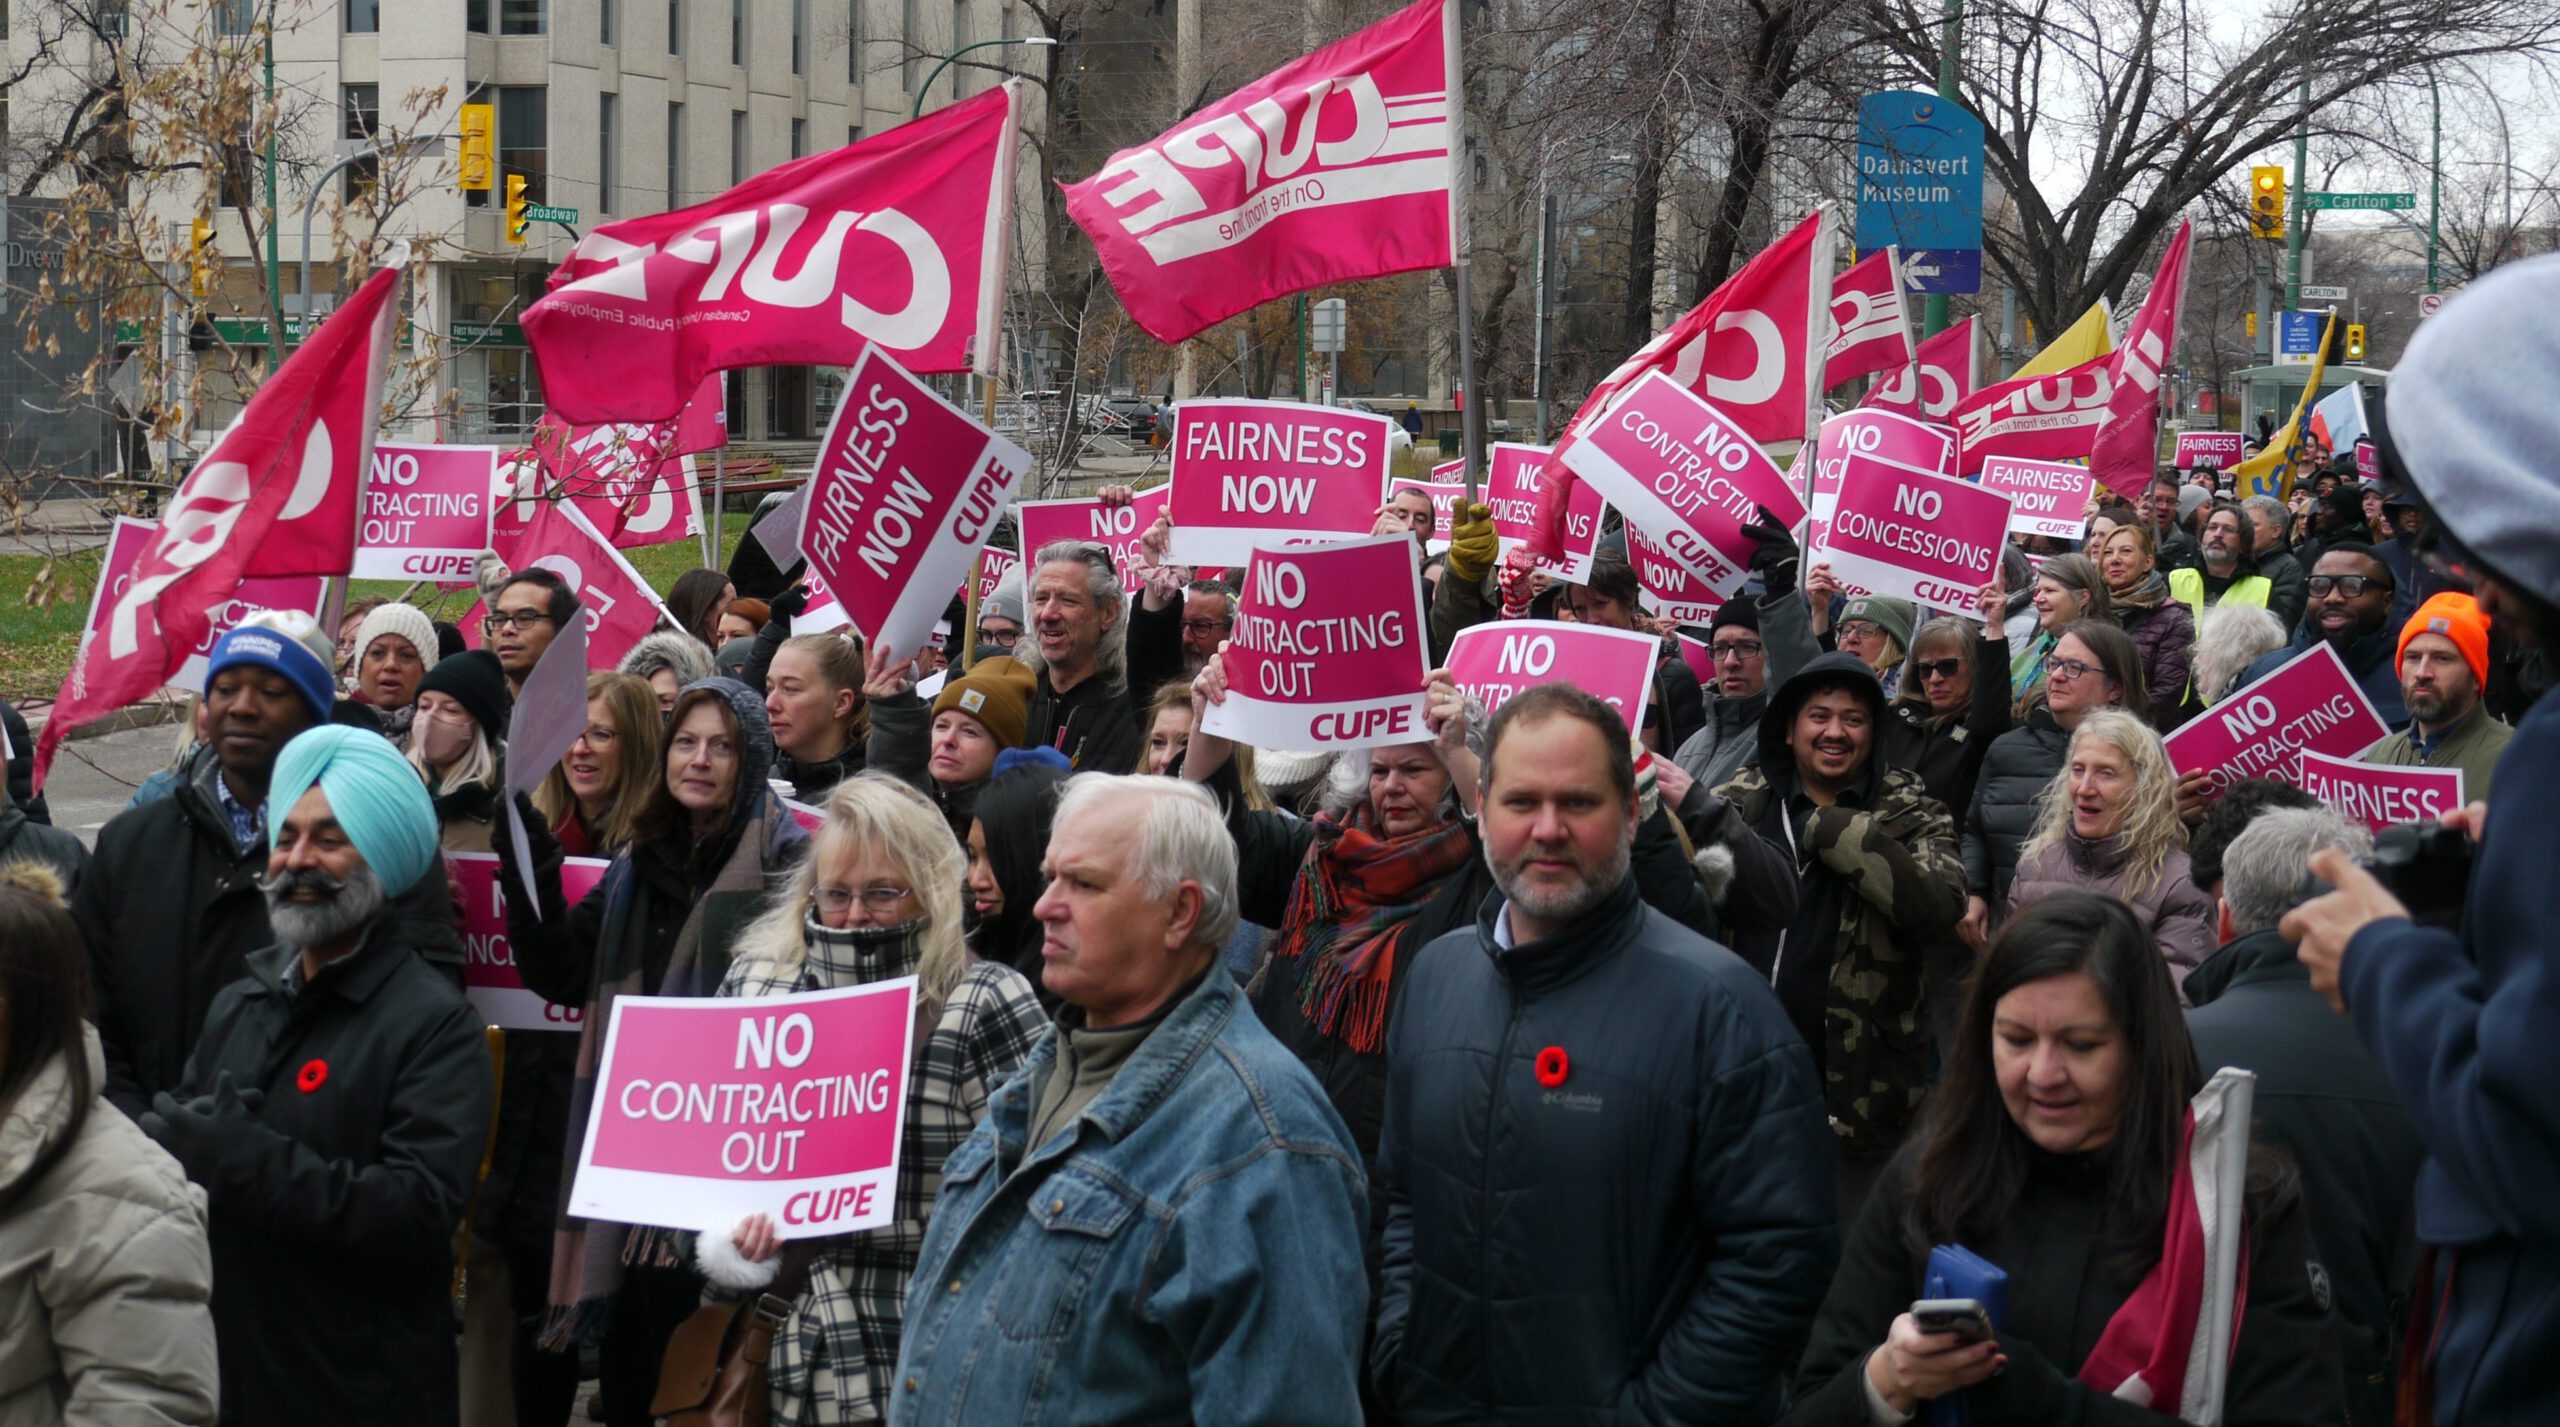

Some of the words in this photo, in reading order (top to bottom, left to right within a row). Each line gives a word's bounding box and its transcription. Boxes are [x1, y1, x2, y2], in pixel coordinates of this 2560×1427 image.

[1863, 184, 1949, 202] Museum
[2332, 196, 2388, 208] Carlton
[2396, 196, 2411, 208] St
[527, 206, 577, 223] Broadway
[2303, 288, 2338, 297] CARLTON
[1186, 421, 1368, 468] FAIRNESS
[1693, 422, 1750, 472] NO
[1838, 424, 1882, 451] NO
[2182, 438, 2236, 452] FAIRNESS
[369, 453, 419, 486] NO
[1991, 465, 2085, 493] FAIRNESS
[2193, 454, 2223, 467] NOW
[814, 383, 909, 577] FAIRNESS
[1222, 475, 1317, 514] NOW
[1655, 471, 1709, 517] OUT
[362, 491, 479, 517] TRACTING
[952, 456, 1013, 545] CUPE
[1893, 483, 1942, 520] NO
[2011, 490, 2058, 513] NOW
[363, 519, 416, 544] OUT
[857, 466, 934, 580] NOW
[1091, 505, 1136, 537] NO
[2036, 521, 2077, 535] CUPE
[1665, 529, 1733, 585] CUPE
[1836, 509, 1993, 572] CONCESSIONS
[403, 555, 475, 576] CUPE
[1257, 559, 1306, 609] NO
[1643, 557, 1687, 593] NOW
[1913, 580, 1978, 610] CUPE
[1497, 635, 1556, 676] NO
[1260, 659, 1316, 698] OUT
[1309, 704, 1412, 742] CUPE
[2221, 694, 2276, 744] NO
[2196, 694, 2356, 796] CONTRACTING
[734, 1013, 814, 1070] NO
[620, 1068, 890, 1124] CONTRACTING
[721, 1130, 805, 1174] OUT
[783, 1182, 878, 1226] CUPE
